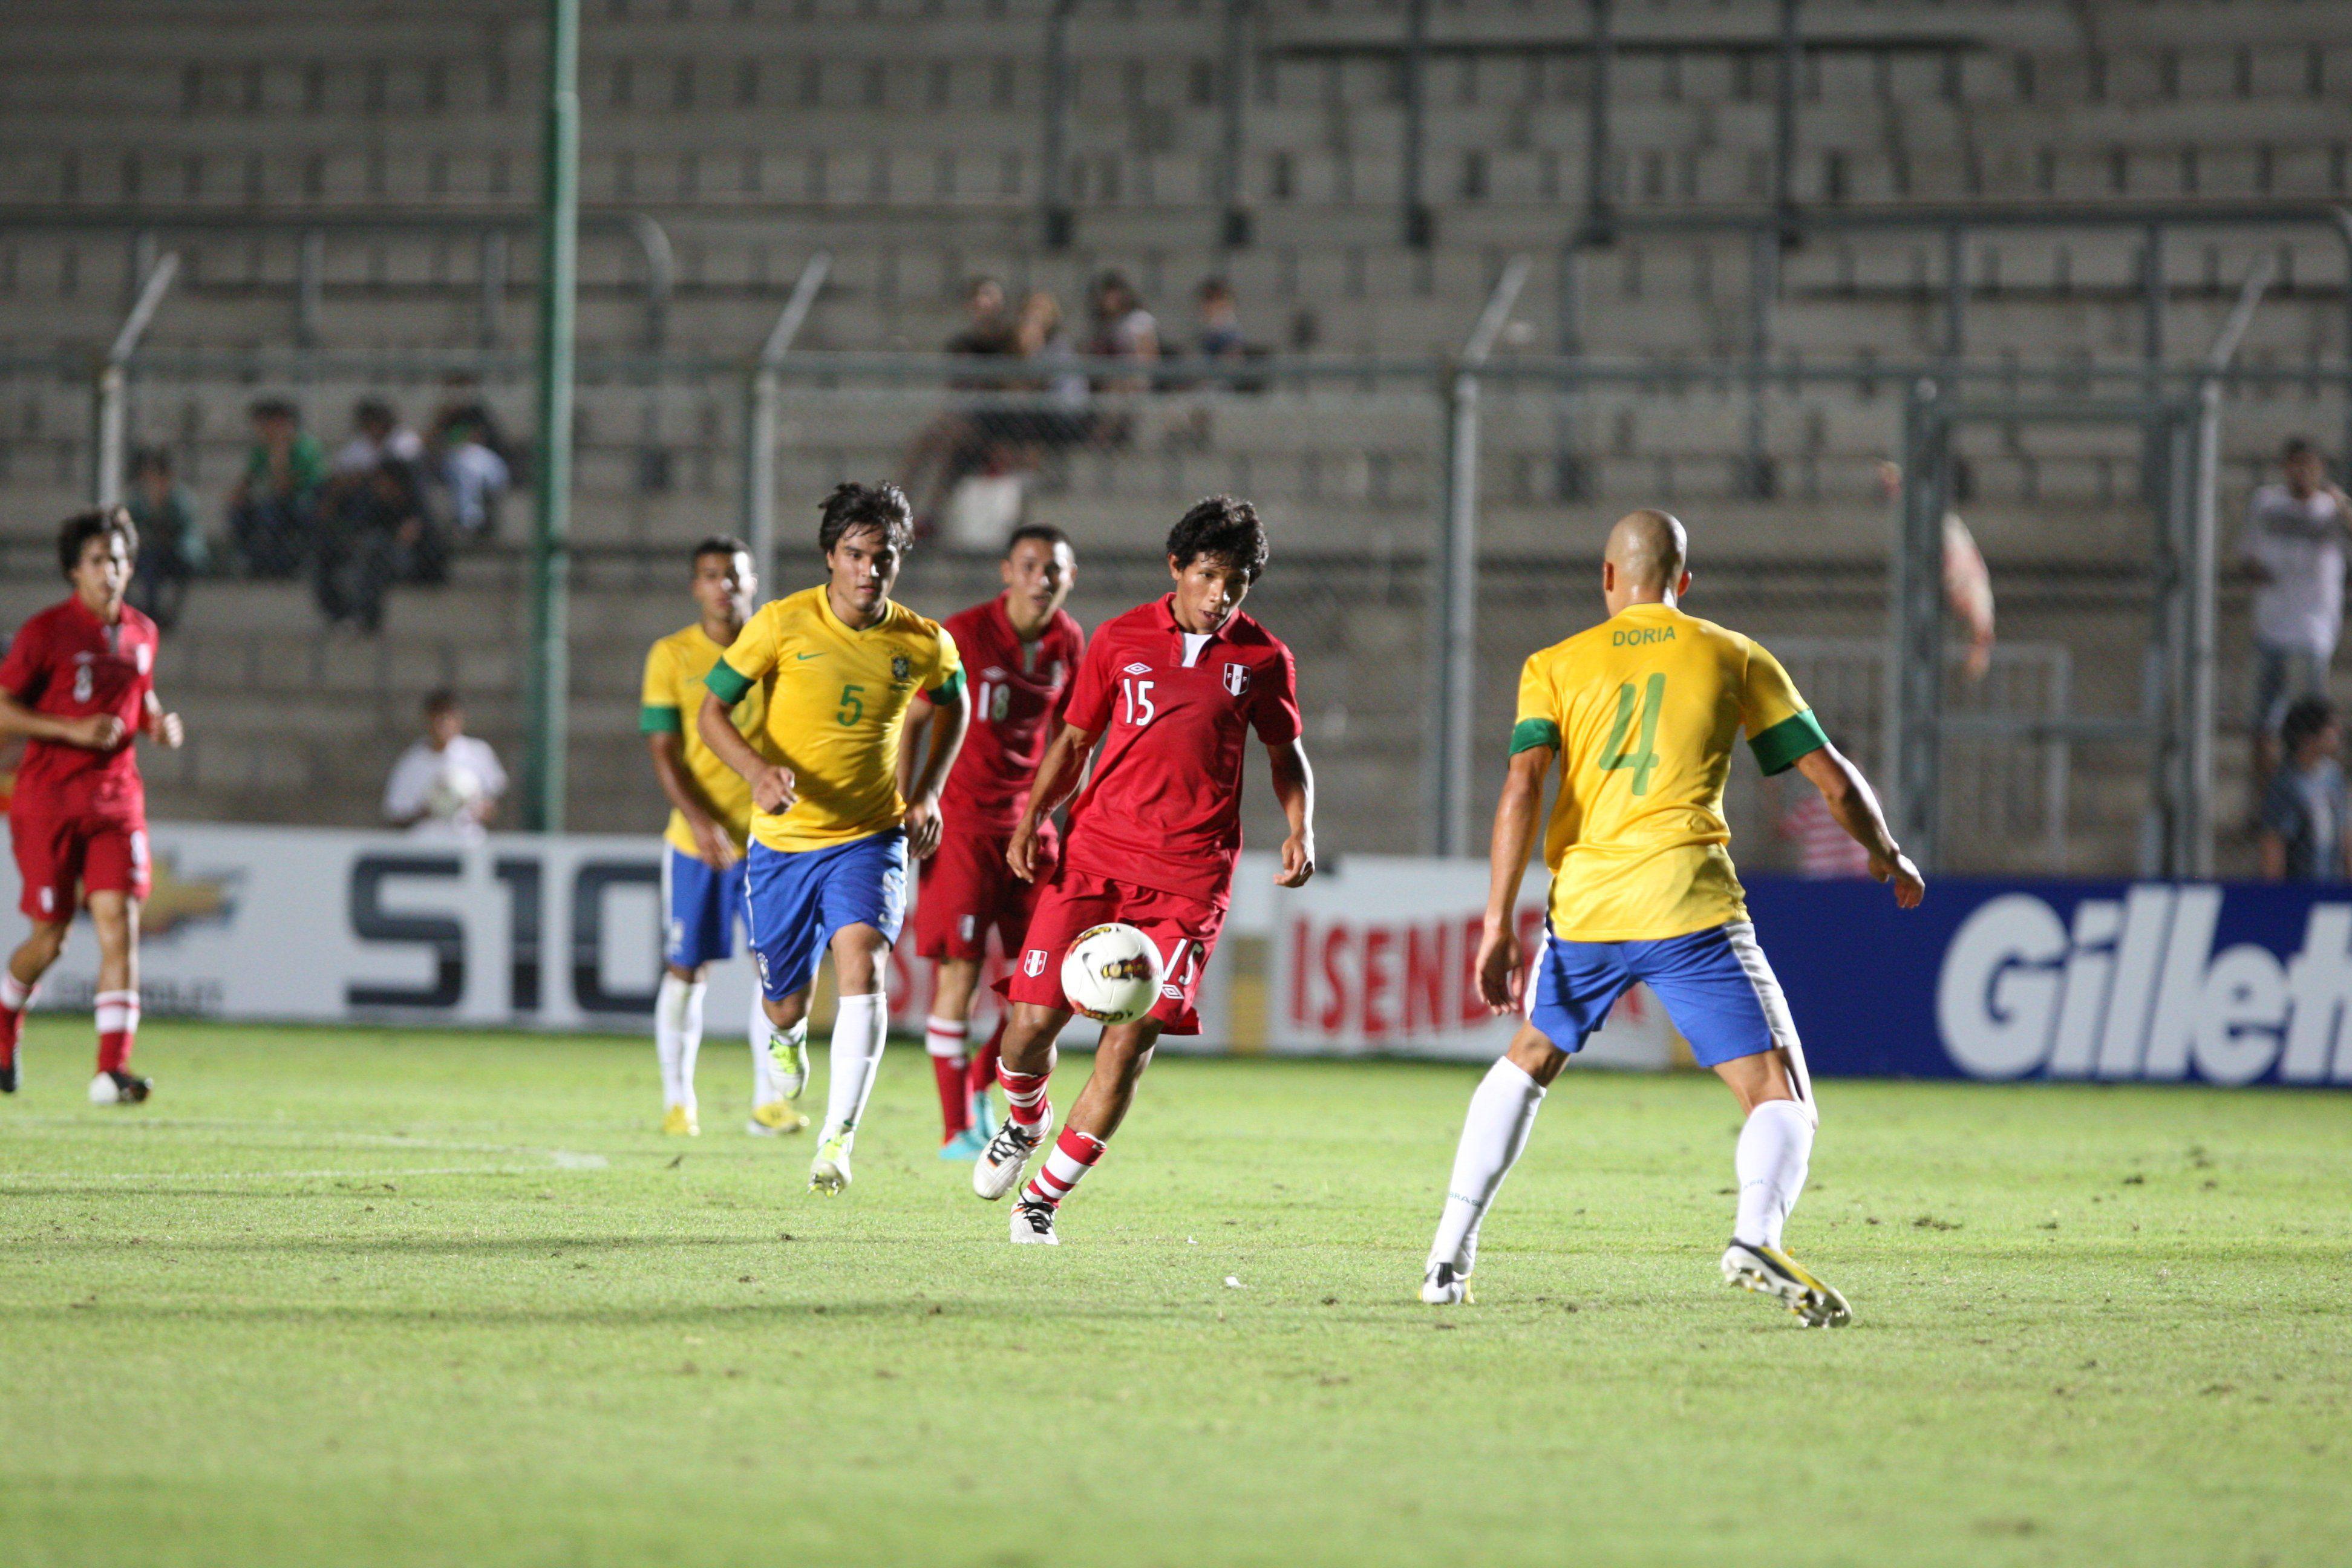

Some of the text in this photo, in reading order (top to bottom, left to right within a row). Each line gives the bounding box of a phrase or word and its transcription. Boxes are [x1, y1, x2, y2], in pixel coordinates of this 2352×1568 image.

[1613, 626, 1676, 646] DORIA
[837, 684, 863, 727] 5
[979, 681, 1011, 721] 18
[1123, 678, 1155, 726] 15
[1598, 672, 1667, 796] 4
